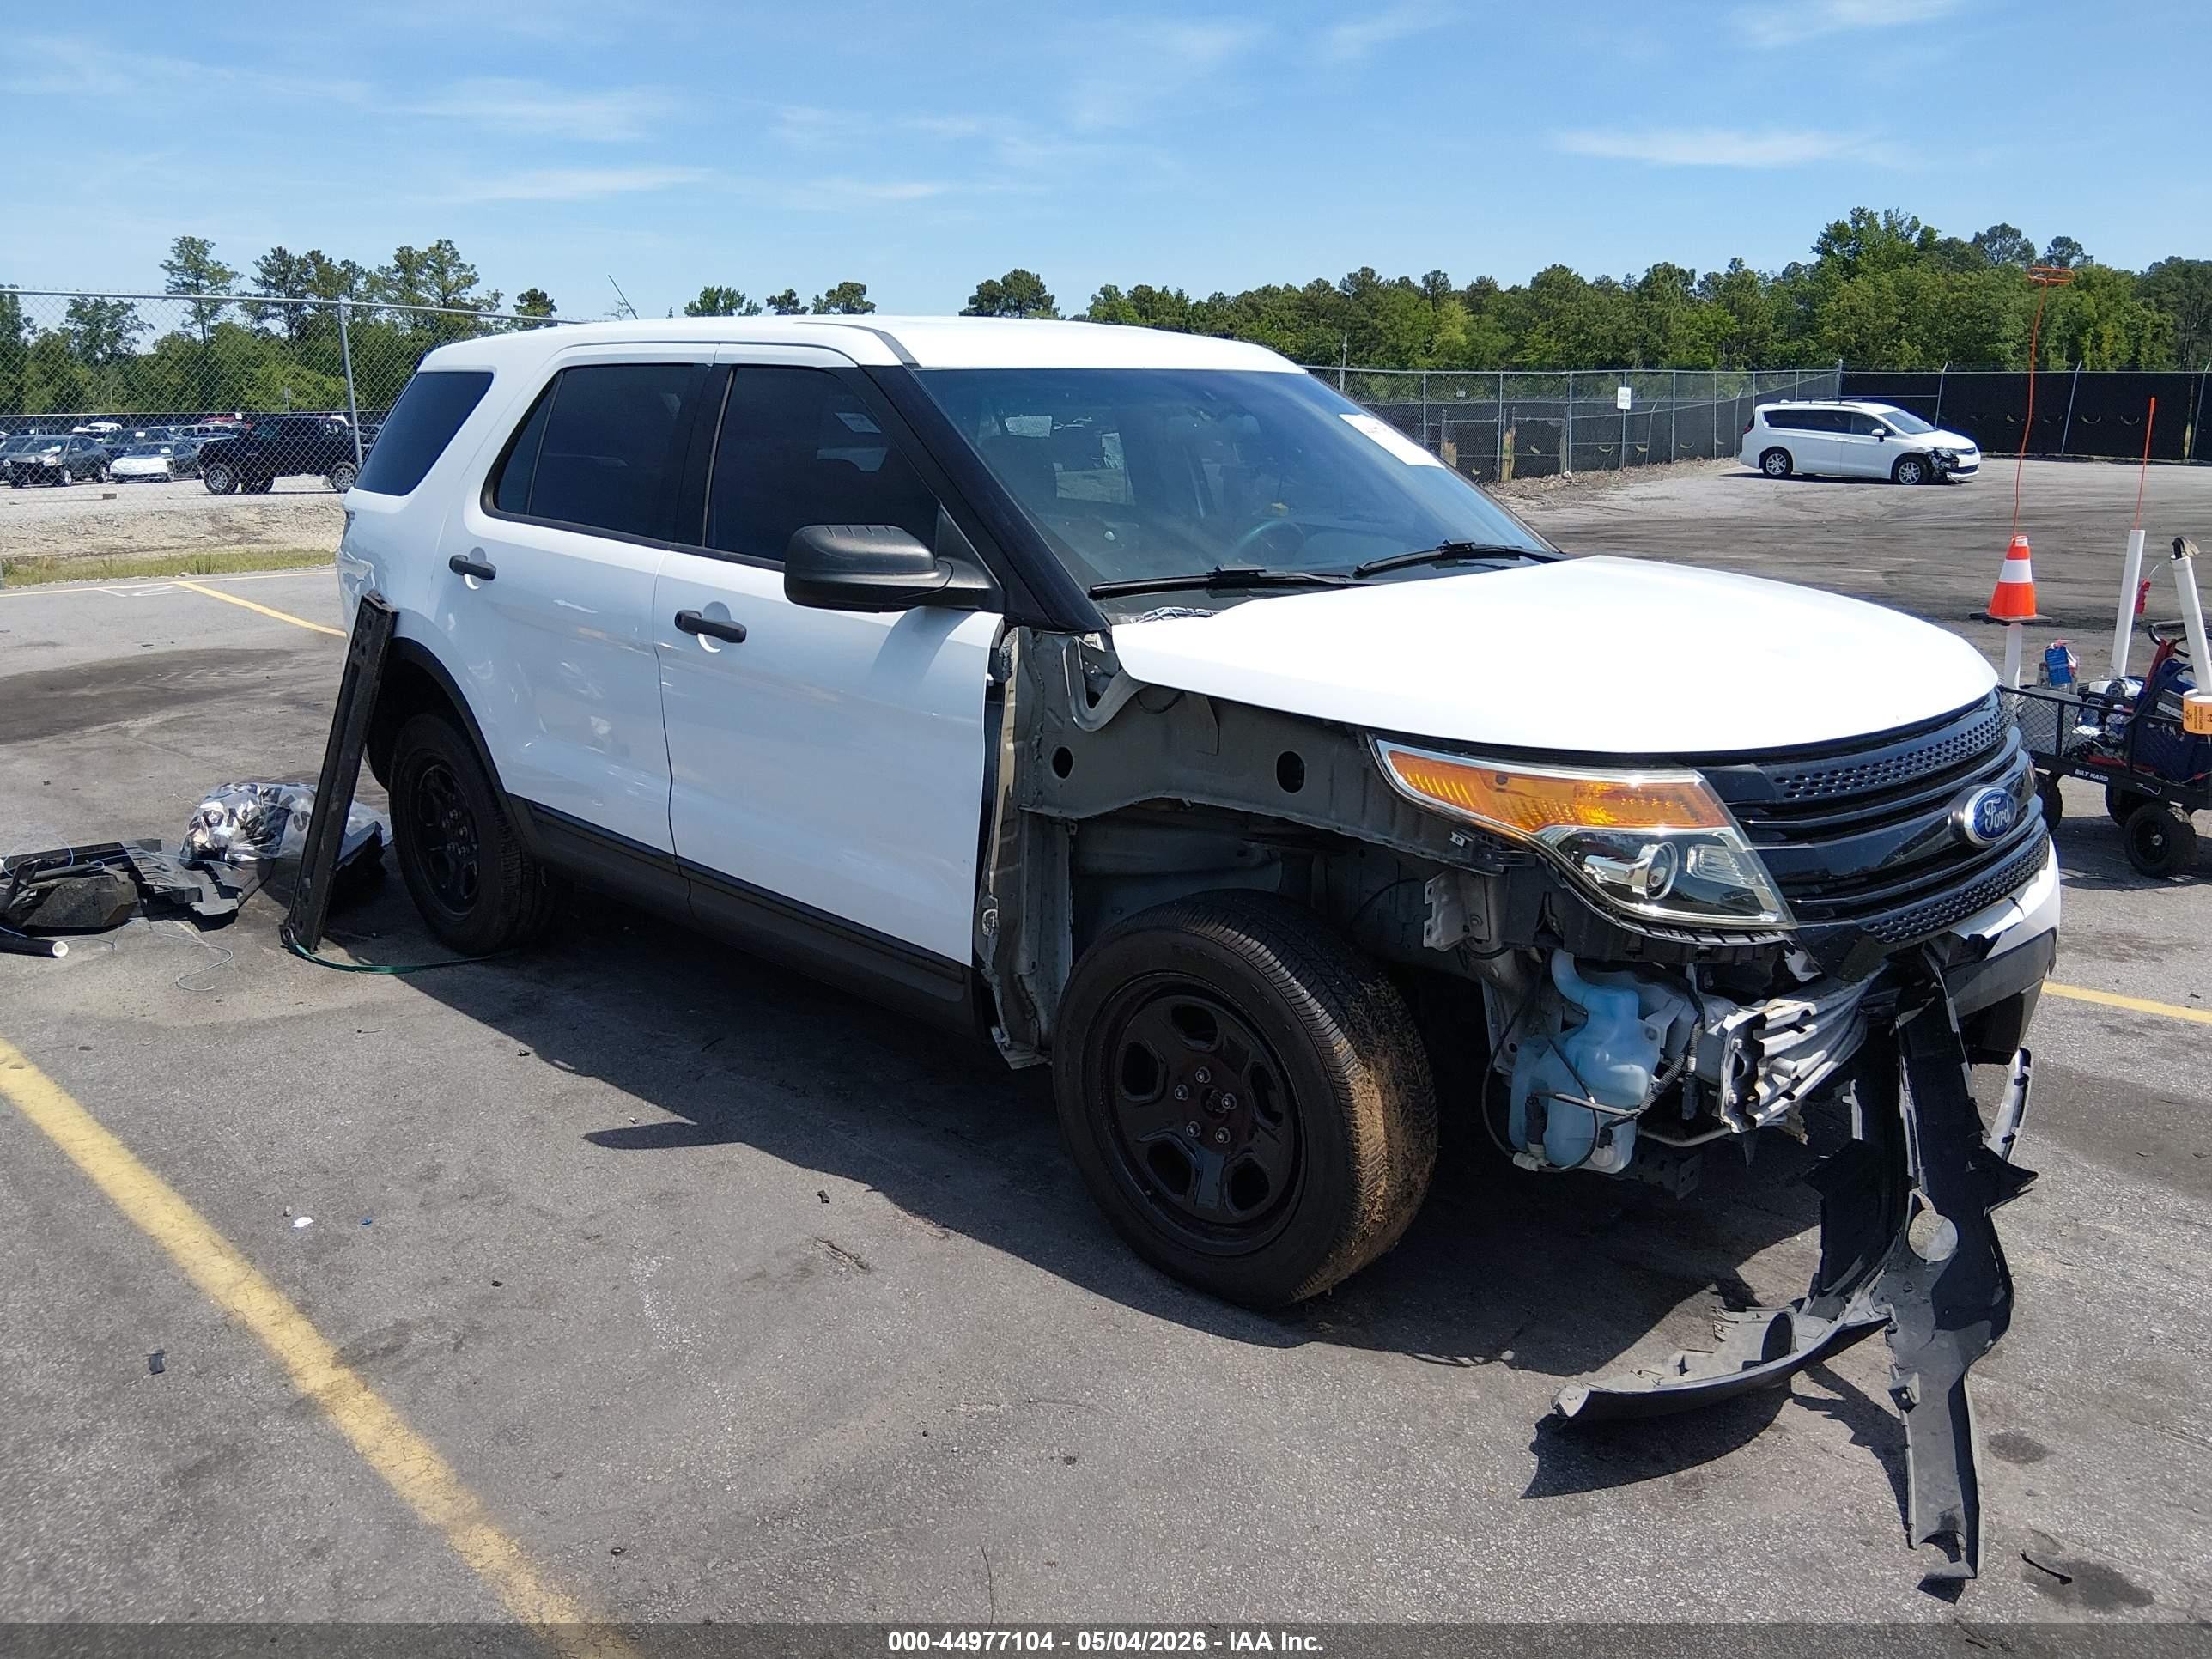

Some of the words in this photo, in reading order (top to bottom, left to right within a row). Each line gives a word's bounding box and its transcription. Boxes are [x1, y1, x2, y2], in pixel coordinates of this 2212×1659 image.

[2075, 769, 2088, 777] BILT
[2090, 773, 2109, 782] HARD
[1984, 796, 2011, 833] Ford
